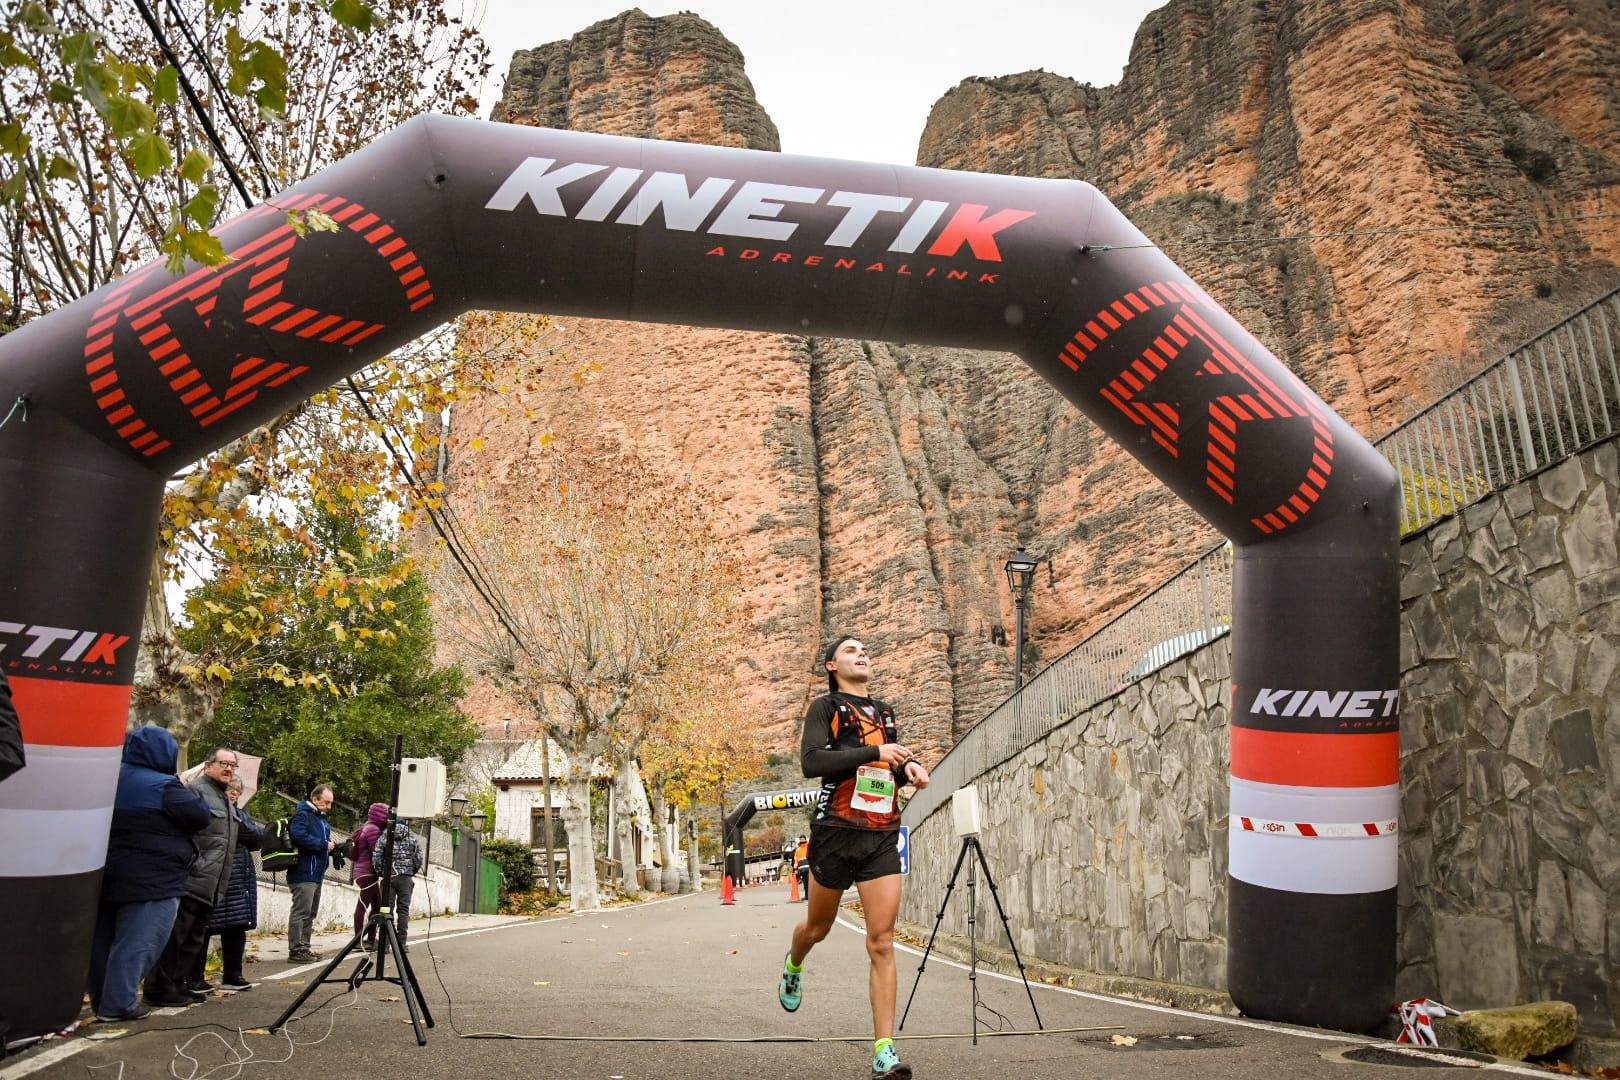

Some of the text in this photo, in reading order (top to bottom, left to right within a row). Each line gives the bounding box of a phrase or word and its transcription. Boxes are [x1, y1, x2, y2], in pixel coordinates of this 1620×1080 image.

[484, 156, 1037, 262] KINETIK
[706, 246, 1003, 284] ADRENALINK
[870, 780, 885, 790] 509
